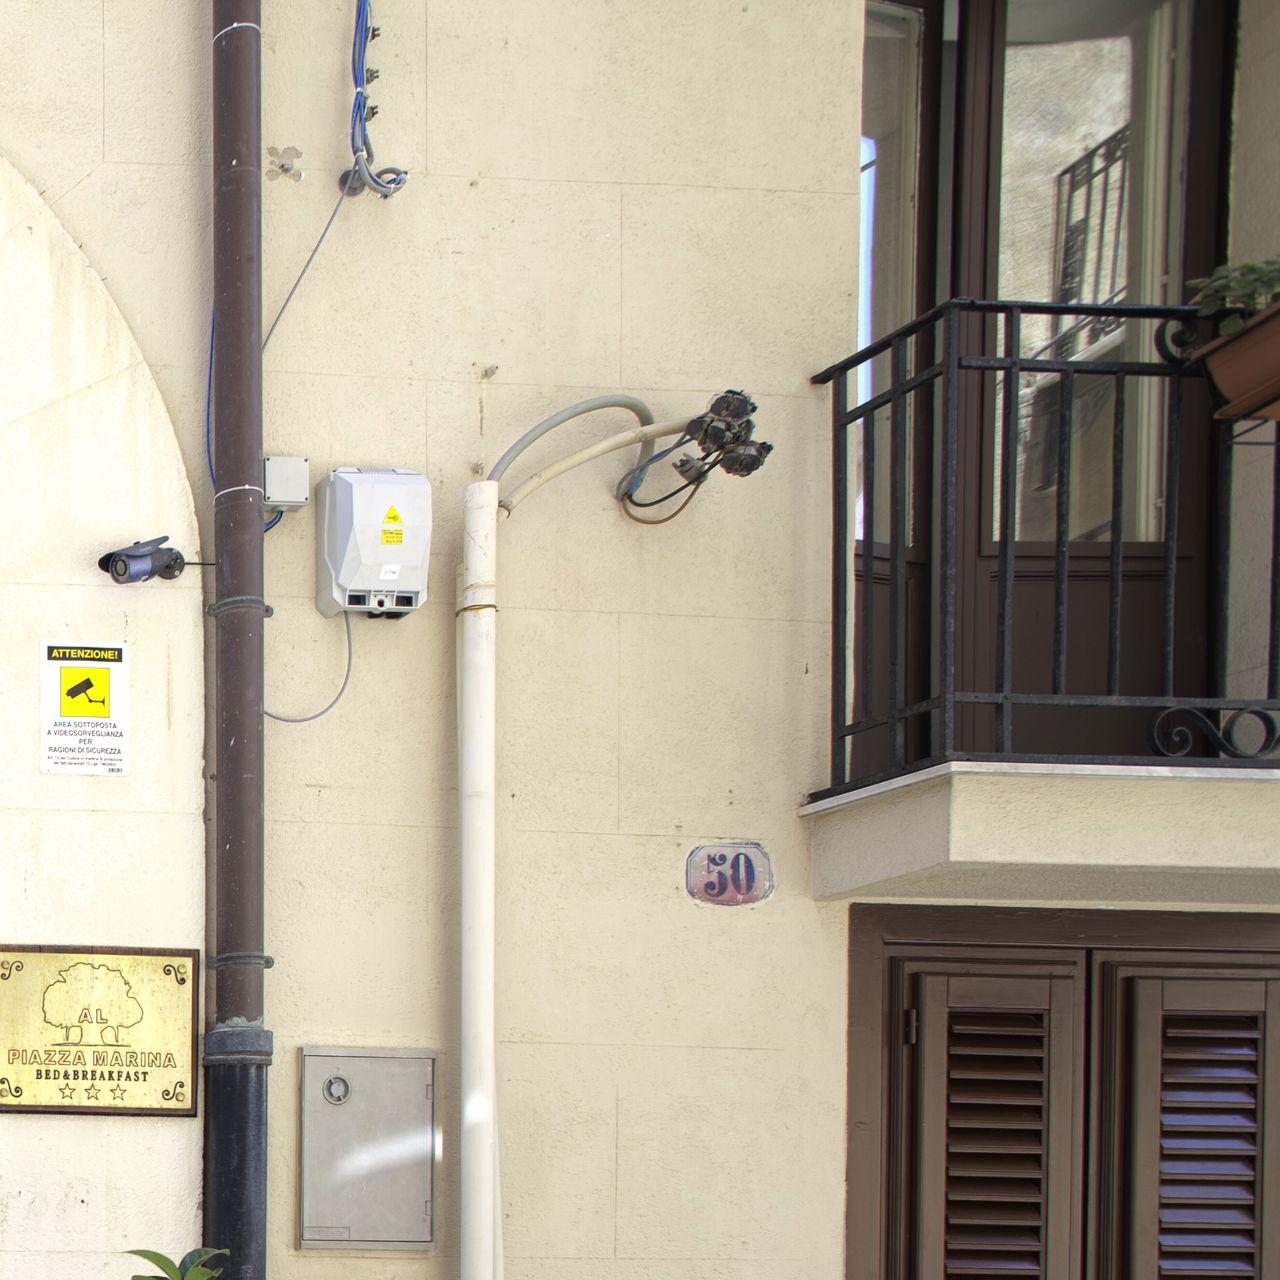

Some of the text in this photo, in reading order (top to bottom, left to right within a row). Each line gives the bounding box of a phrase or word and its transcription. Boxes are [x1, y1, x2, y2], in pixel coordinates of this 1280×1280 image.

[51, 649, 118, 660] ATTENZIONE!
[73, 721, 118, 729] SOTTOPOSTA
[53, 729, 124, 738] VIDEOSORVEGLIANZA
[85, 747, 122, 755] SICUREZZA
[703, 852, 755, 897] 50
[78, 1008, 108, 1024] AL
[7, 1048, 177, 1068] PIAZZA MARINA
[35, 1069, 150, 1083] BED&BREAKFAST
